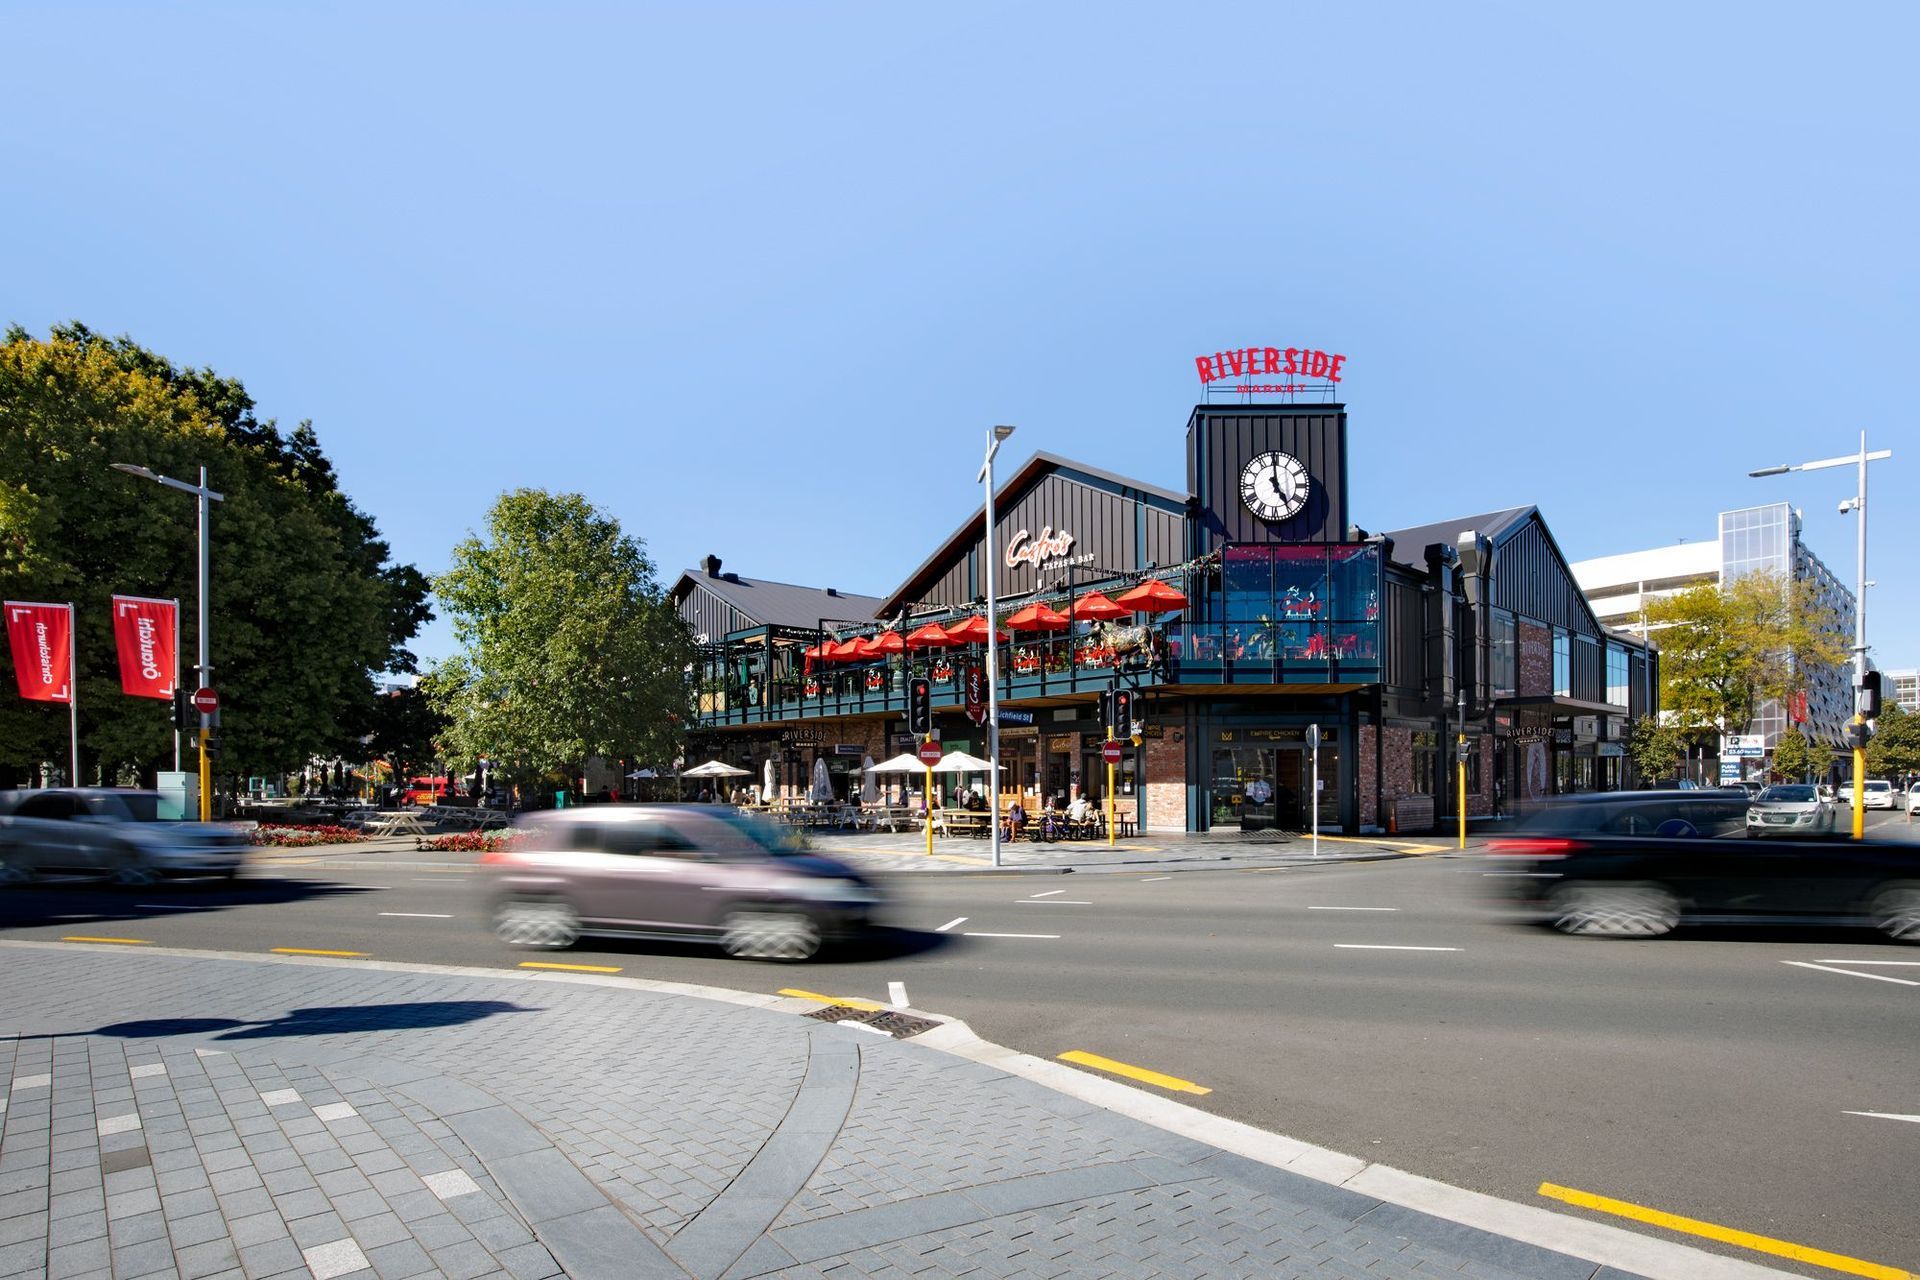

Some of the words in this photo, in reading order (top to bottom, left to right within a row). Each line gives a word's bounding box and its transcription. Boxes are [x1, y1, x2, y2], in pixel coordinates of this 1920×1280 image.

[1195, 347, 1347, 385] RIVERSIDE
[1236, 384, 1306, 394] MARKET
[1043, 558, 1068, 571] TAPAS
[1069, 557, 1075, 565] &
[1078, 553, 1095, 564] BAR
[1022, 713, 1029, 722] St
[1506, 727, 1553, 738] RIVERSIDE
